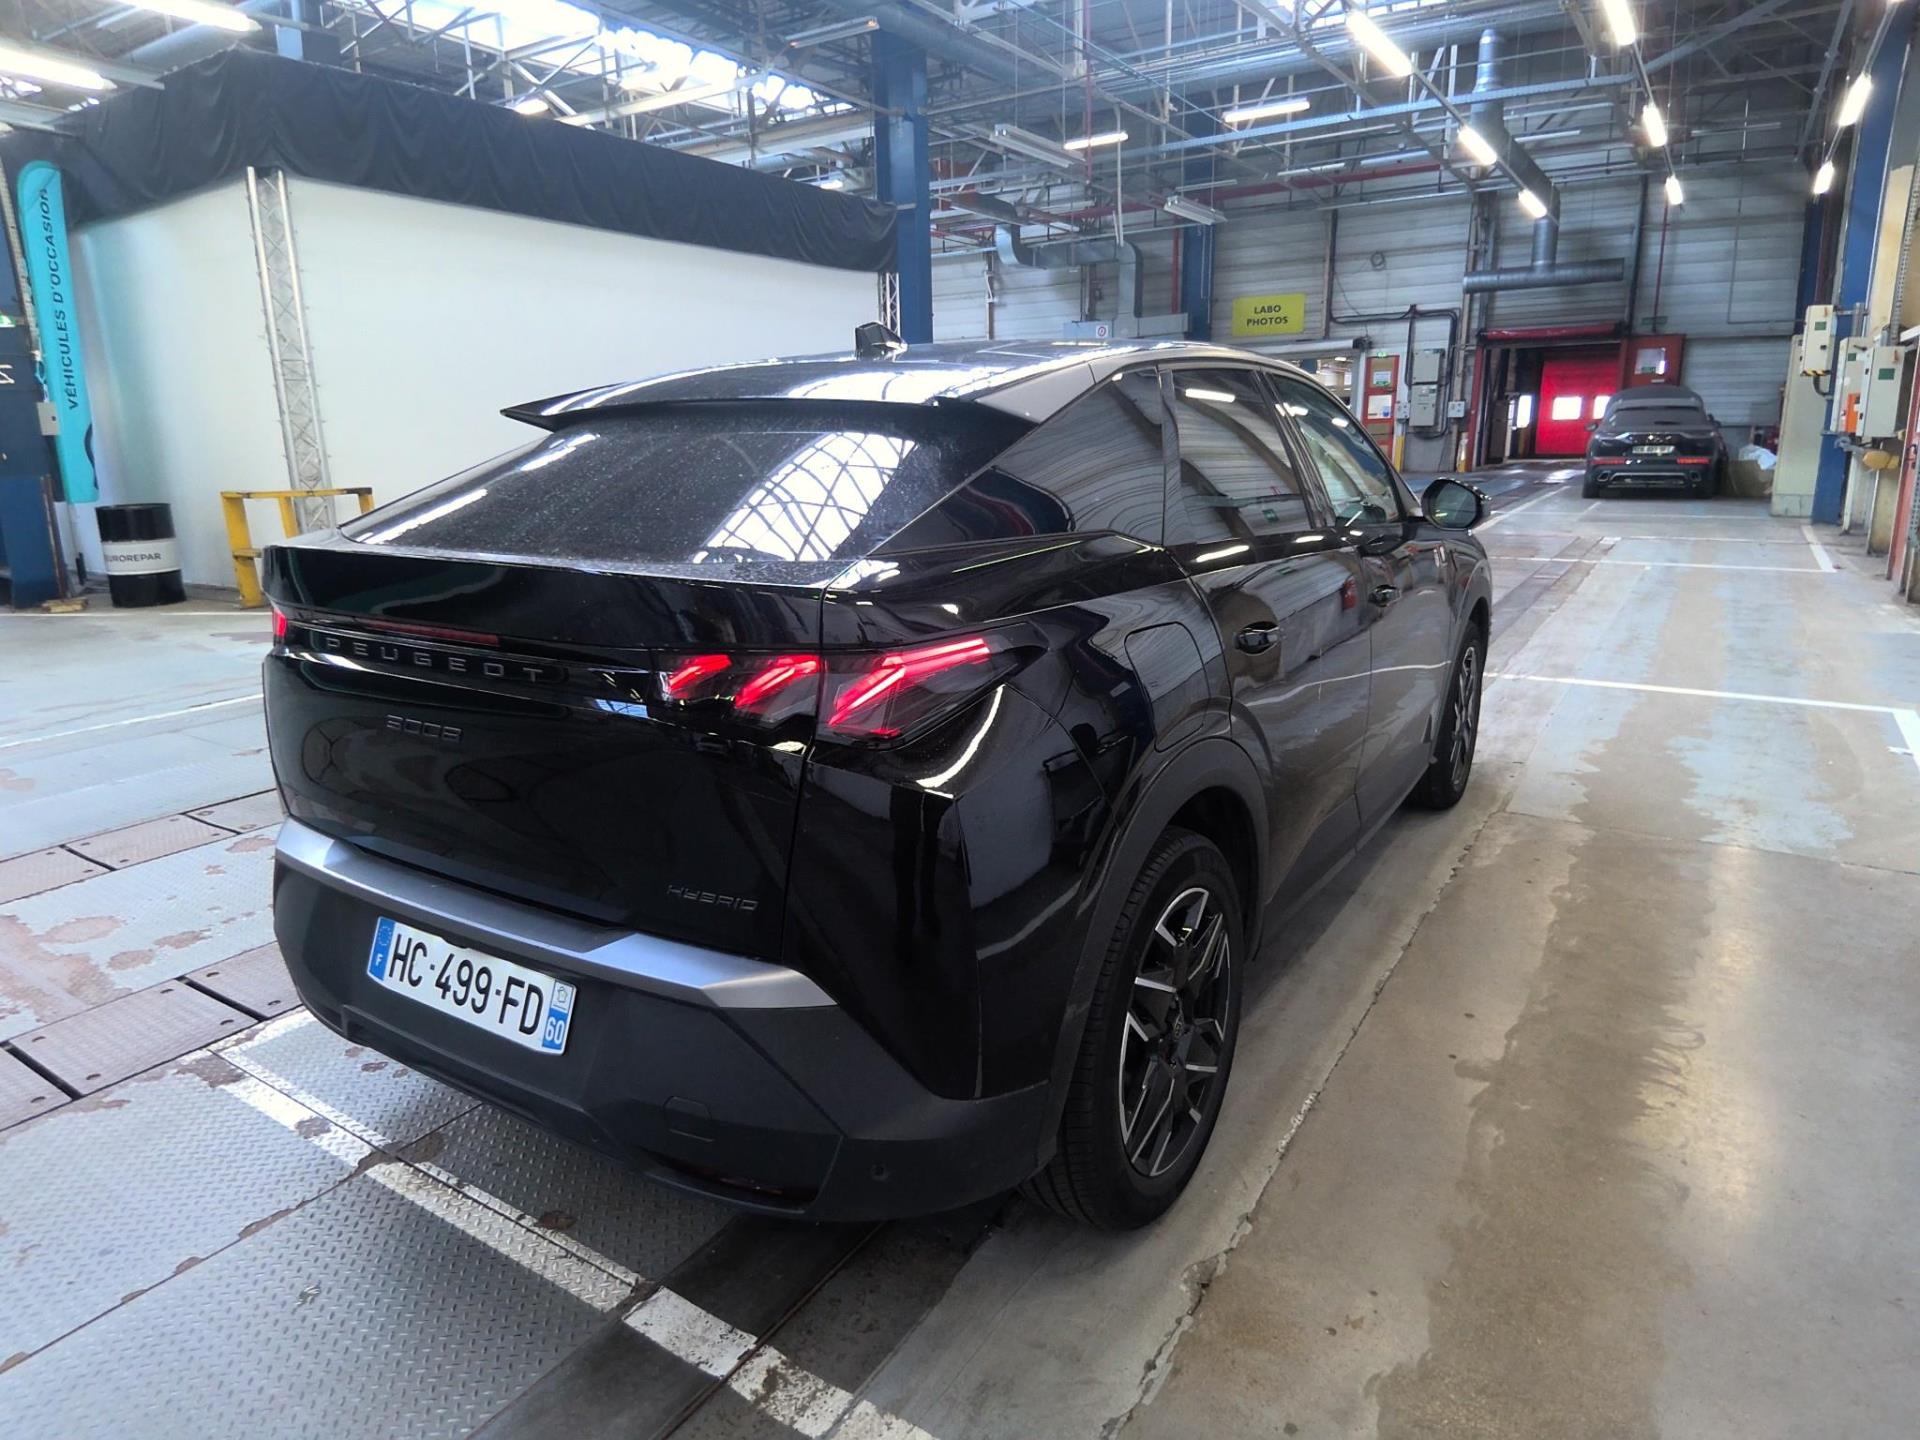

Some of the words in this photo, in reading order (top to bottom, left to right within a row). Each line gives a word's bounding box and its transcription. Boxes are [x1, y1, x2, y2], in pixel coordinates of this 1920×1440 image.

[1254, 304, 1282, 314] LABO
[1246, 316, 1289, 327] PHOTOS
[326, 637, 543, 682] PEUGEOT
[667, 885, 758, 910] HYBRID
[375, 954, 383, 967] F
[544, 1016, 566, 1045] 60
